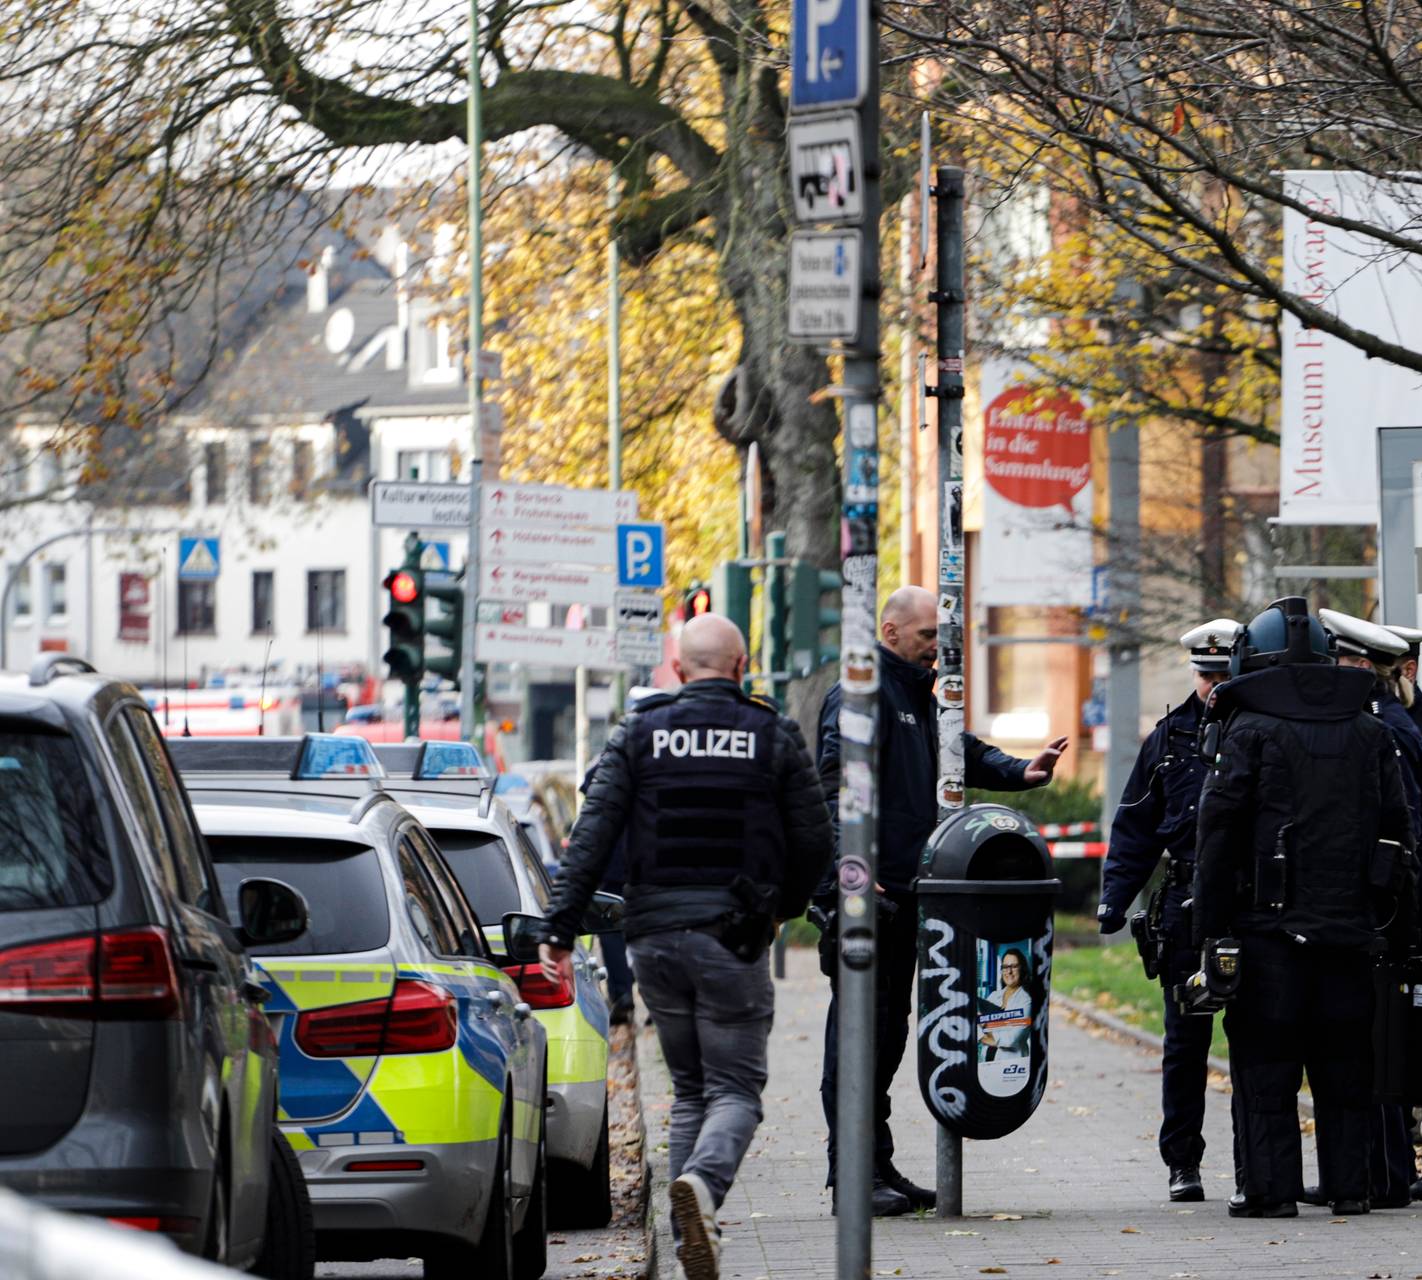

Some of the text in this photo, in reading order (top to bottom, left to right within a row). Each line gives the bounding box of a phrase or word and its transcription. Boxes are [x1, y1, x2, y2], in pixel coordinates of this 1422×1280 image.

[986, 432, 1038, 454] in die
[1293, 361, 1324, 498] Museum
[986, 455, 1089, 488] Sammlung!
[626, 531, 653, 580] P
[652, 728, 756, 759] POLIZEI
